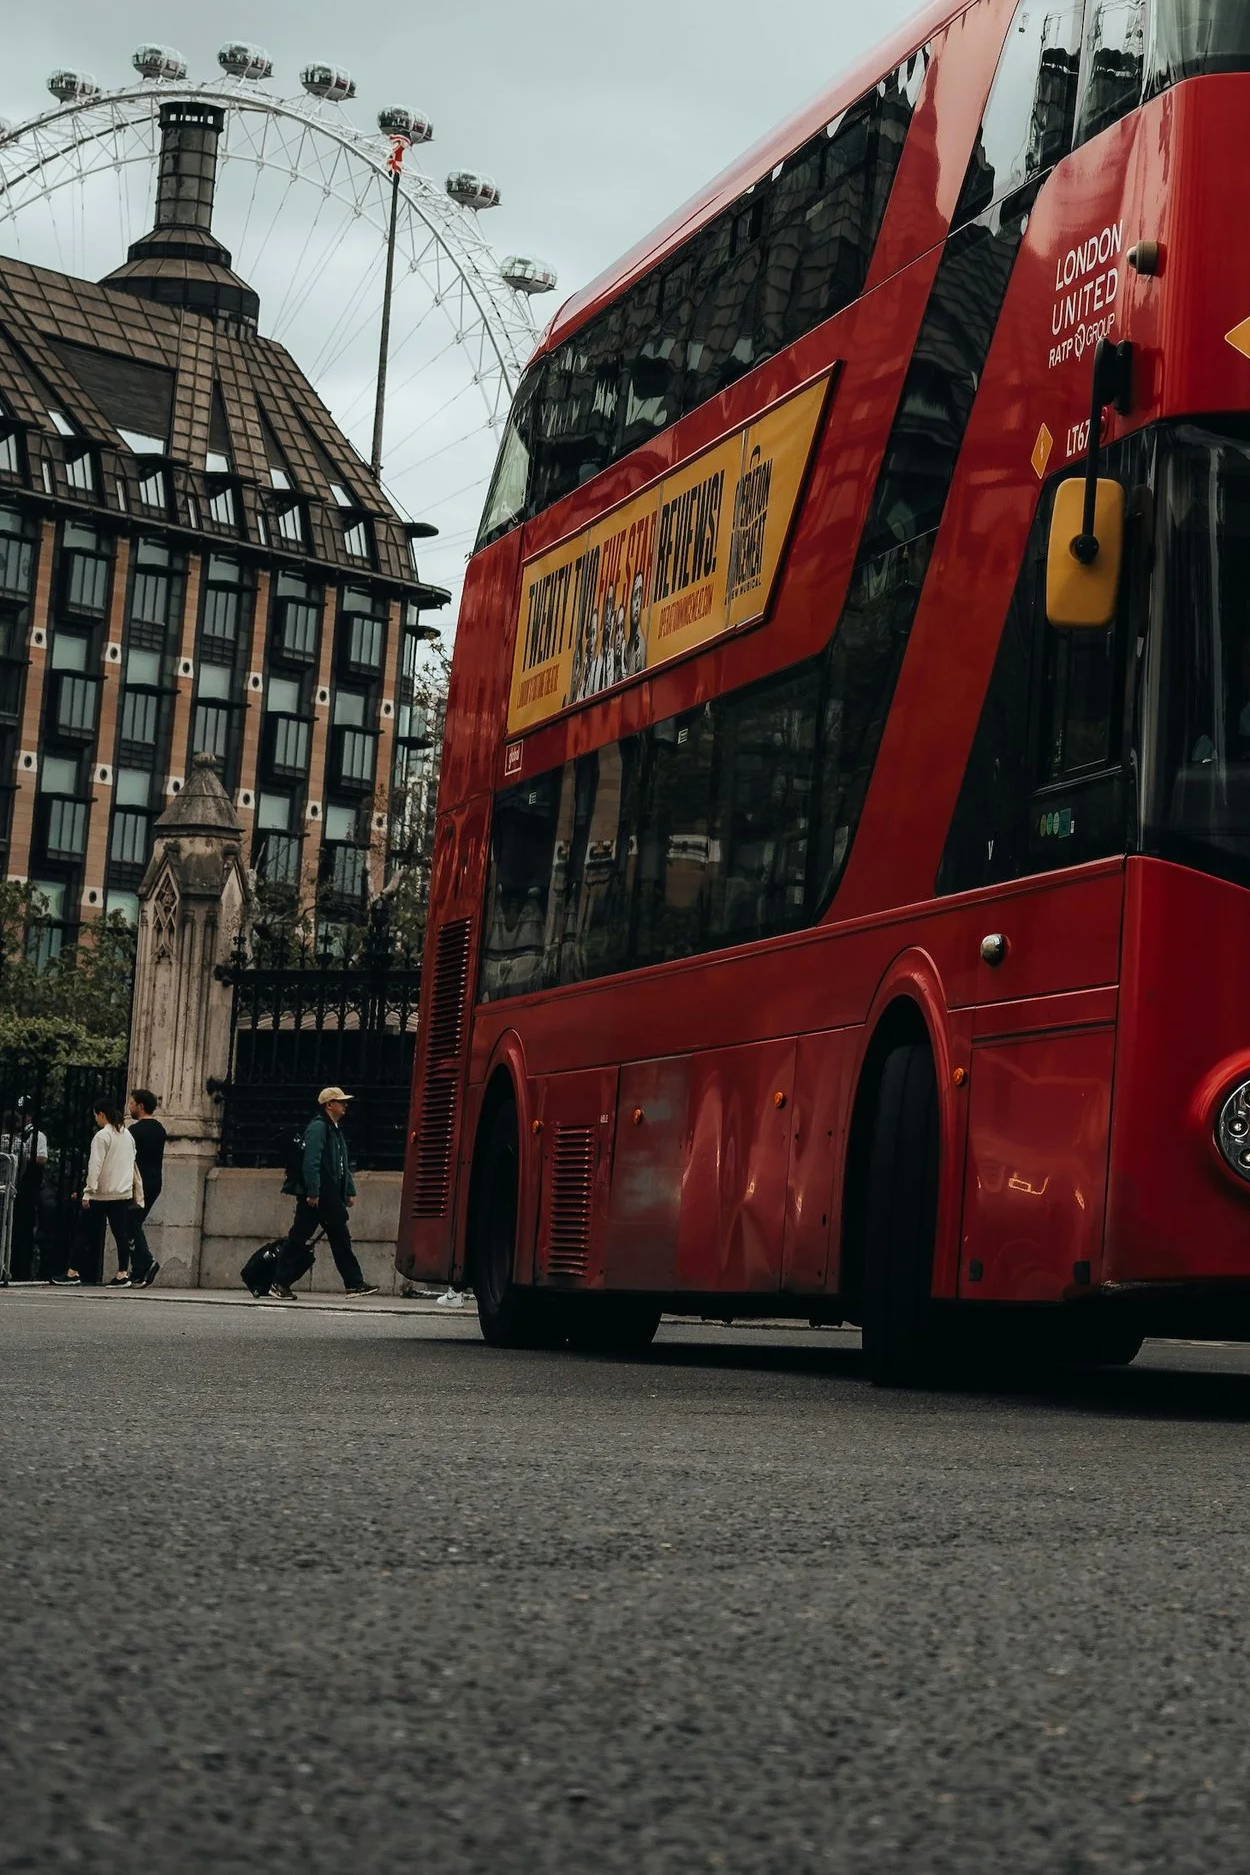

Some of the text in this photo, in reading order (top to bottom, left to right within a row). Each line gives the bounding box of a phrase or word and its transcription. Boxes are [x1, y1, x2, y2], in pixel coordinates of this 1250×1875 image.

[1055, 219, 1123, 292] LONDON
[1052, 267, 1119, 336] UNITED
[1048, 313, 1116, 369] RATP GROUP
[1066, 419, 1091, 458] LT67
[522, 562, 572, 673] TWENTY
[568, 545, 600, 649] TWO
[653, 469, 725, 603] REVIEWS!
